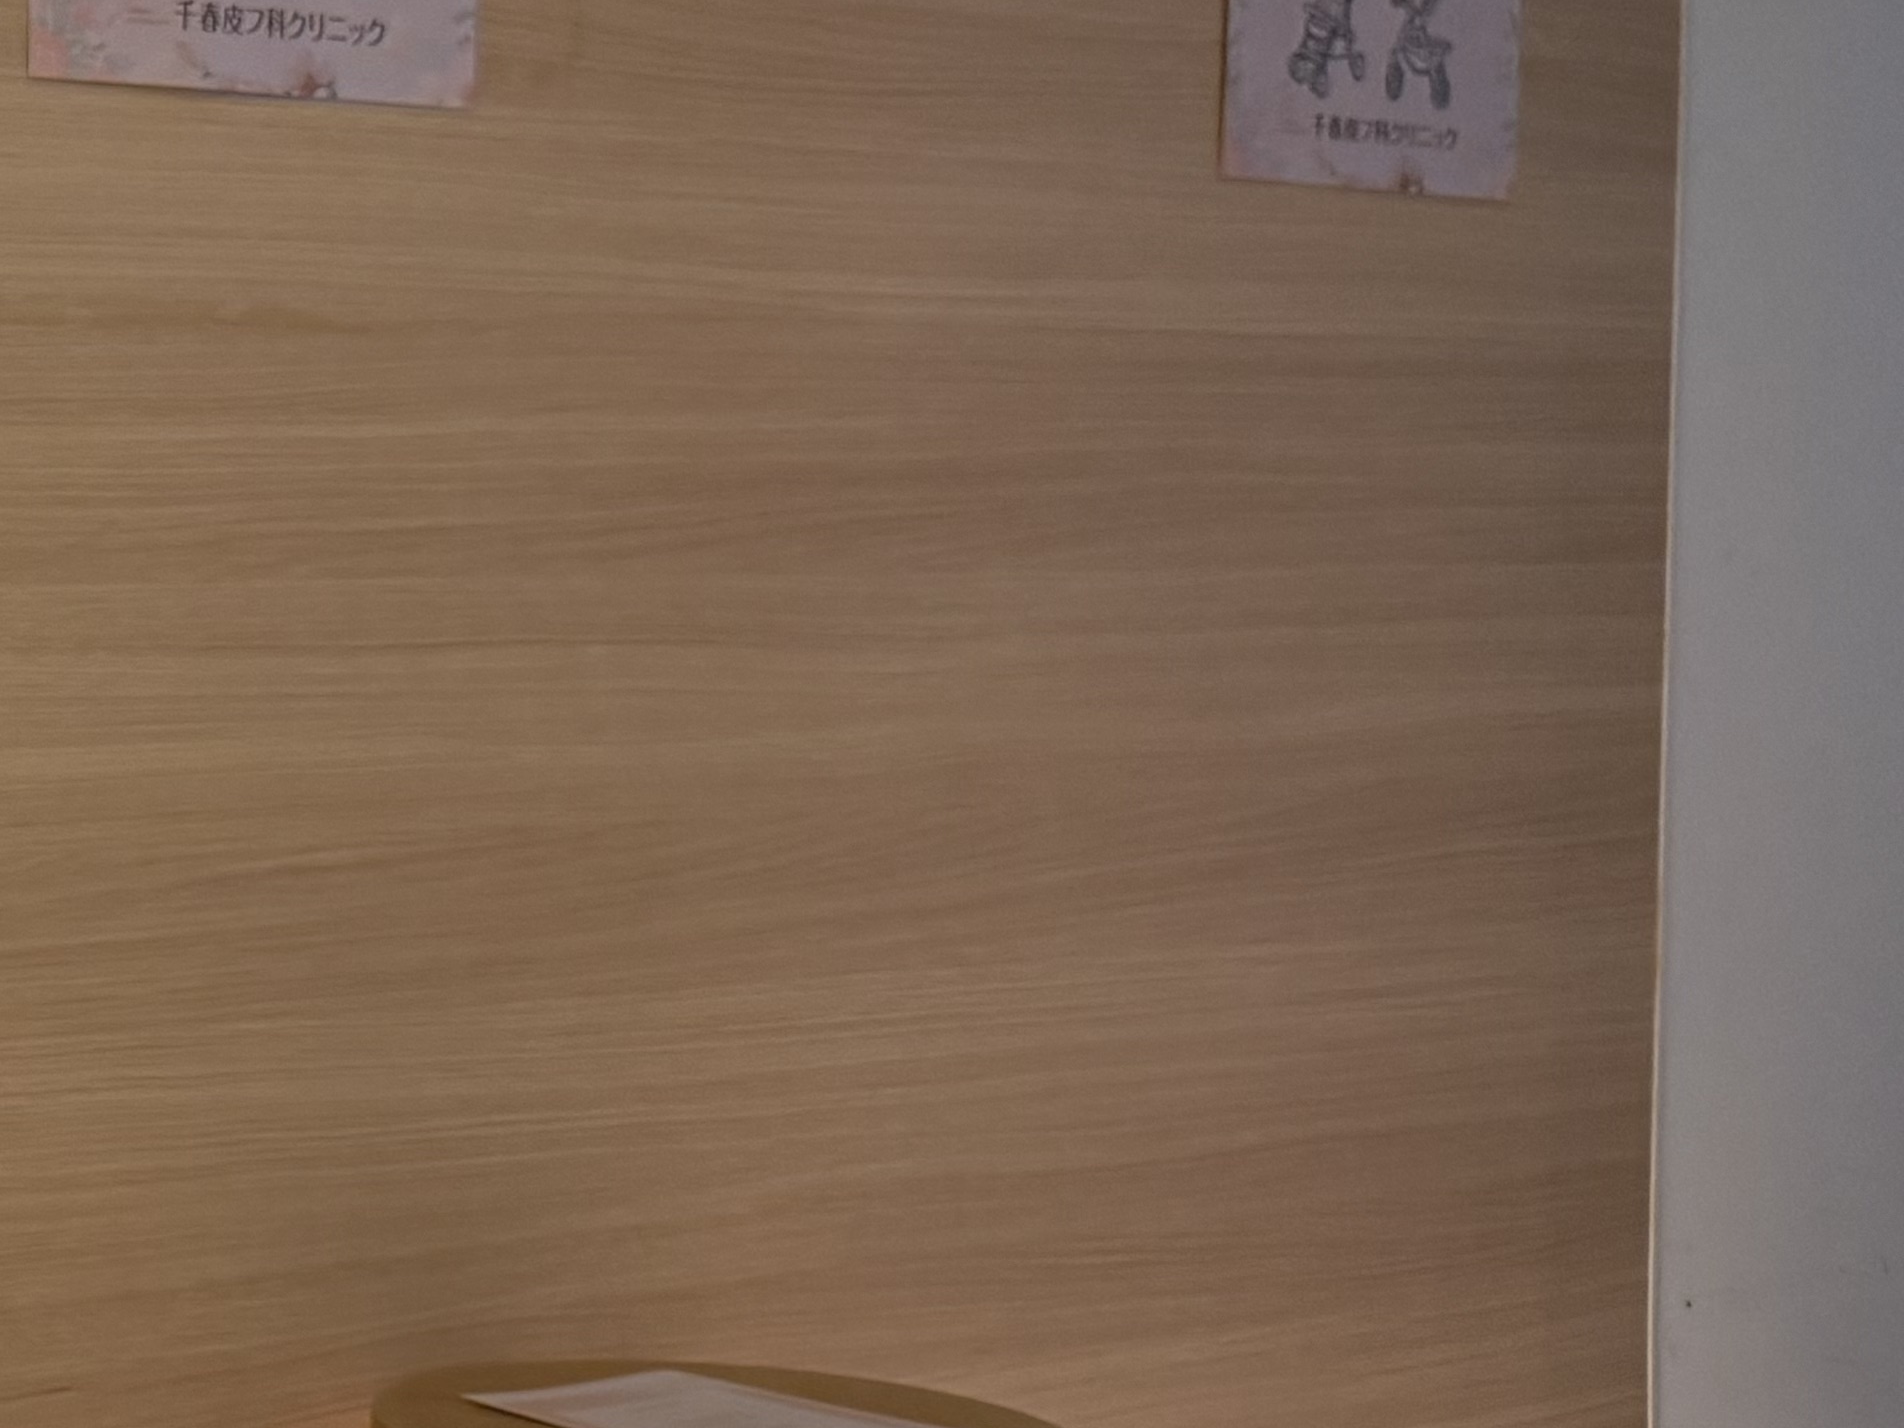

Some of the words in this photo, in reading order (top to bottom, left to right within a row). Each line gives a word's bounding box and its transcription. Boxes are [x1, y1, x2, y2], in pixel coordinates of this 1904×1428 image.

[175, 0, 387, 48] 千春皮フ科クリニック
